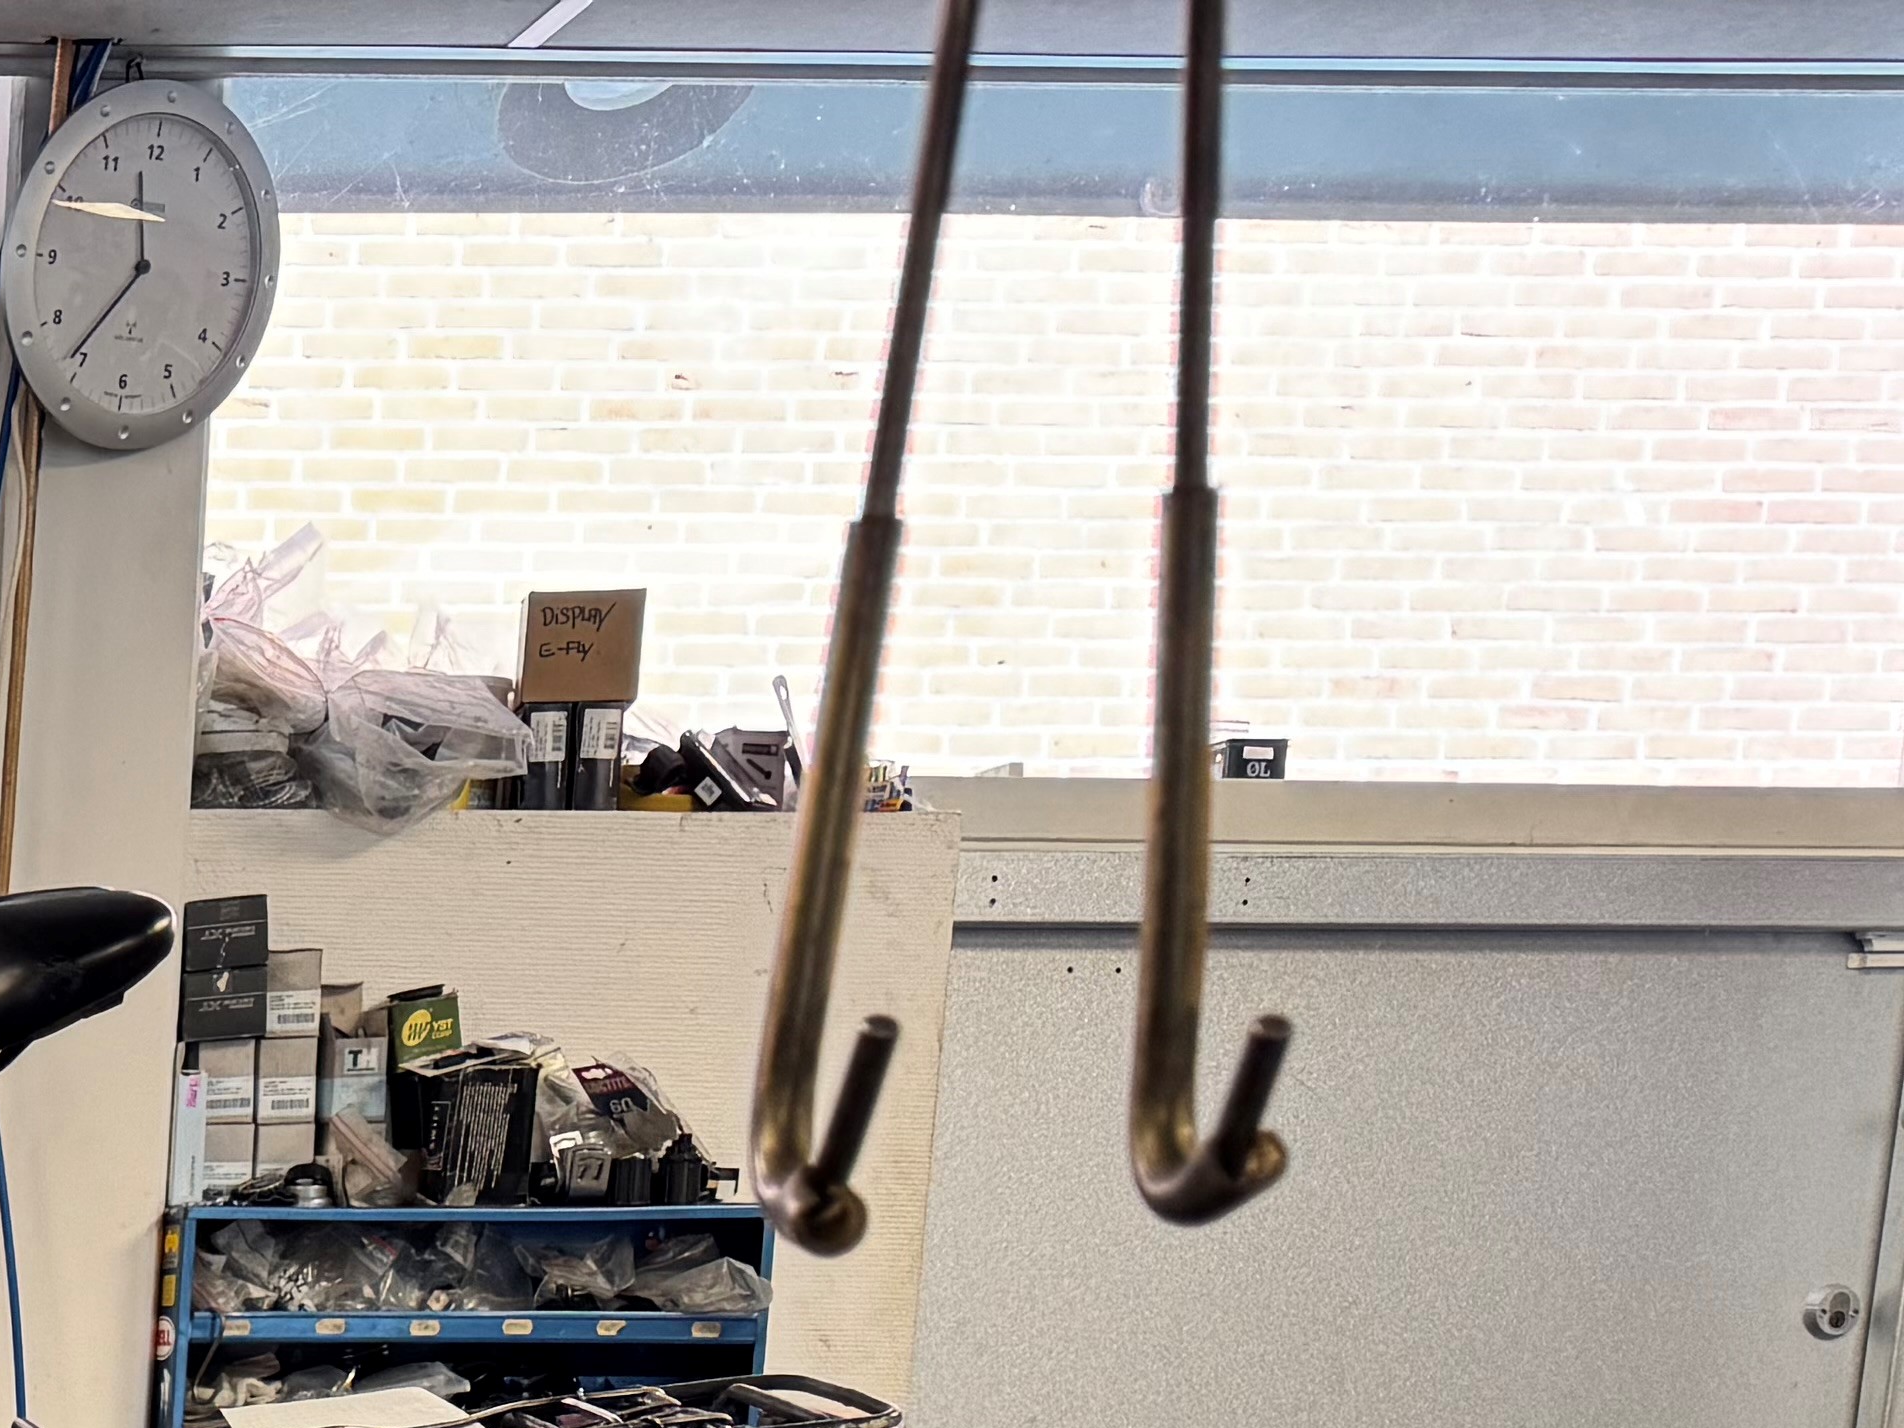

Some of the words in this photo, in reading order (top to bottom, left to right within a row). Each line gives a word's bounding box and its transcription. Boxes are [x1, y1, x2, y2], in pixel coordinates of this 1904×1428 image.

[148, 145, 165, 161] 12
[102, 156, 119, 172] 11
[193, 167, 201, 182] 1
[217, 214, 227, 229] 2
[47, 250, 57, 264] 9
[220, 272, 231, 287] 3
[52, 310, 63, 325] 8
[197, 328, 208, 343] 4
[79, 352, 88, 367] 7
[163, 363, 173, 379] 5
[118, 374, 128, 389] 6
